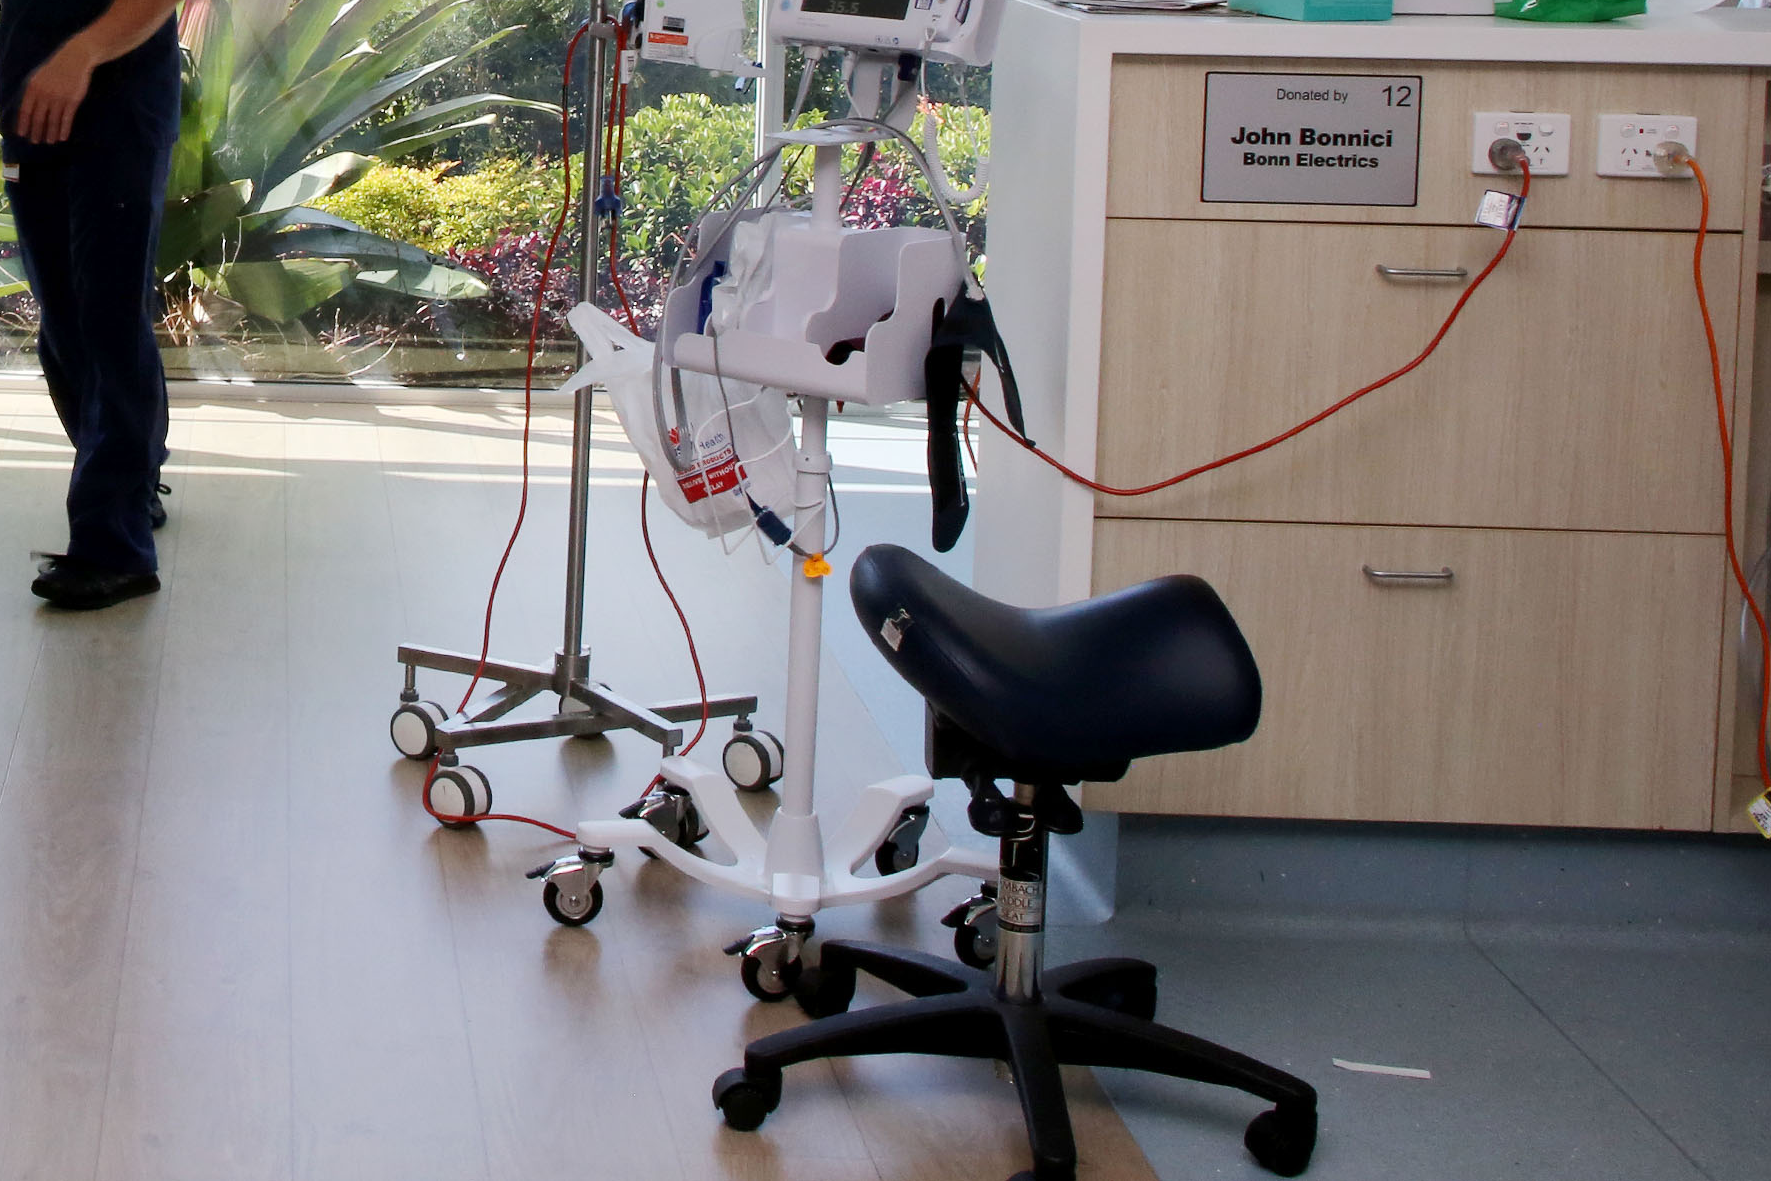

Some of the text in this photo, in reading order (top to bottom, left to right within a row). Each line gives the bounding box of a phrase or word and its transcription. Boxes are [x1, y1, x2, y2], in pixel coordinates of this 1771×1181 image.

[827, 0, 860, 14] 35.5
[1277, 88, 1348, 104] Donated by
[1382, 85, 1412, 107] 12
[1231, 127, 1393, 147] John Bonnici
[1243, 152, 1379, 169] Bonn Electrics
[1002, 880, 1039, 896] MBACH
[1000, 897, 1034, 909] ADDLE
